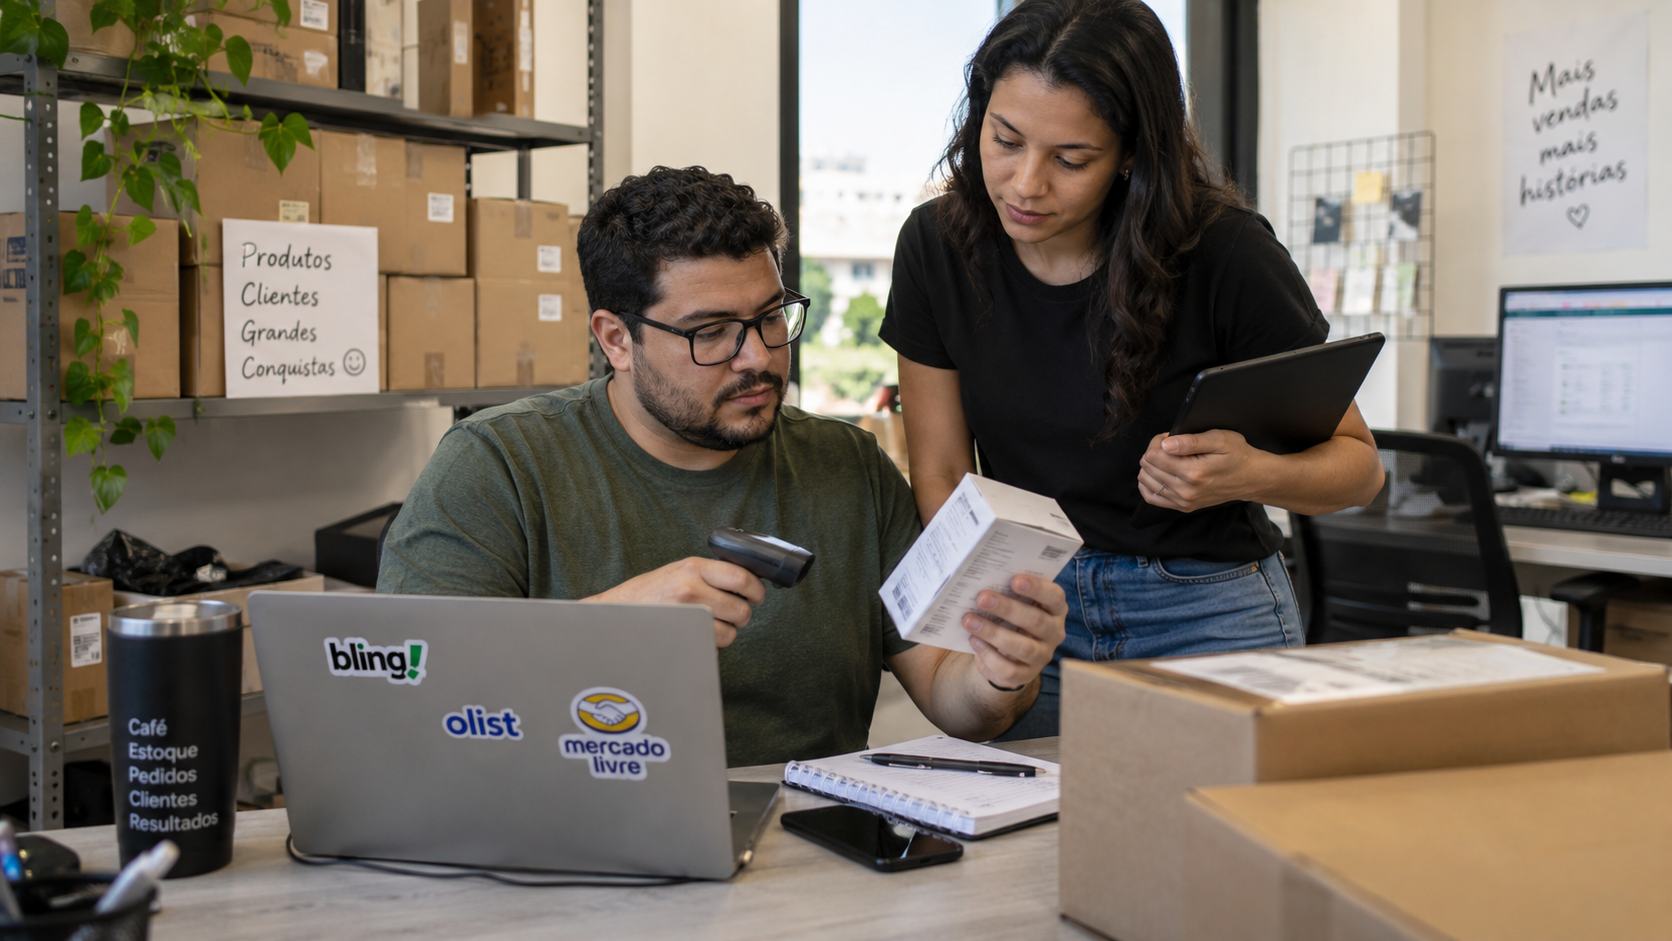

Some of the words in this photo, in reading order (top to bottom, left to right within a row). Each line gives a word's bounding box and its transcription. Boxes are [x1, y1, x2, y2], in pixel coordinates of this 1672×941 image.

[1528, 58, 1595, 105] Mais
[1532, 86, 1619, 134] vendas
[1539, 130, 1598, 165] mais
[1520, 159, 1627, 208] histórias
[242, 242, 332, 271] Produtos
[241, 282, 319, 307] Clientes
[241, 319, 317, 347] Grandes
[241, 356, 335, 385] Conquistas
[329, 642, 423, 680] bling!
[128, 717, 168, 737] Café
[446, 708, 520, 737] olist
[128, 742, 198, 763] Estoque
[564, 738, 666, 757] mercado
[129, 766, 197, 785] Pedidos
[593, 756, 641, 775] livre
[129, 790, 198, 809] Clientes
[129, 812, 219, 832] Resultados
